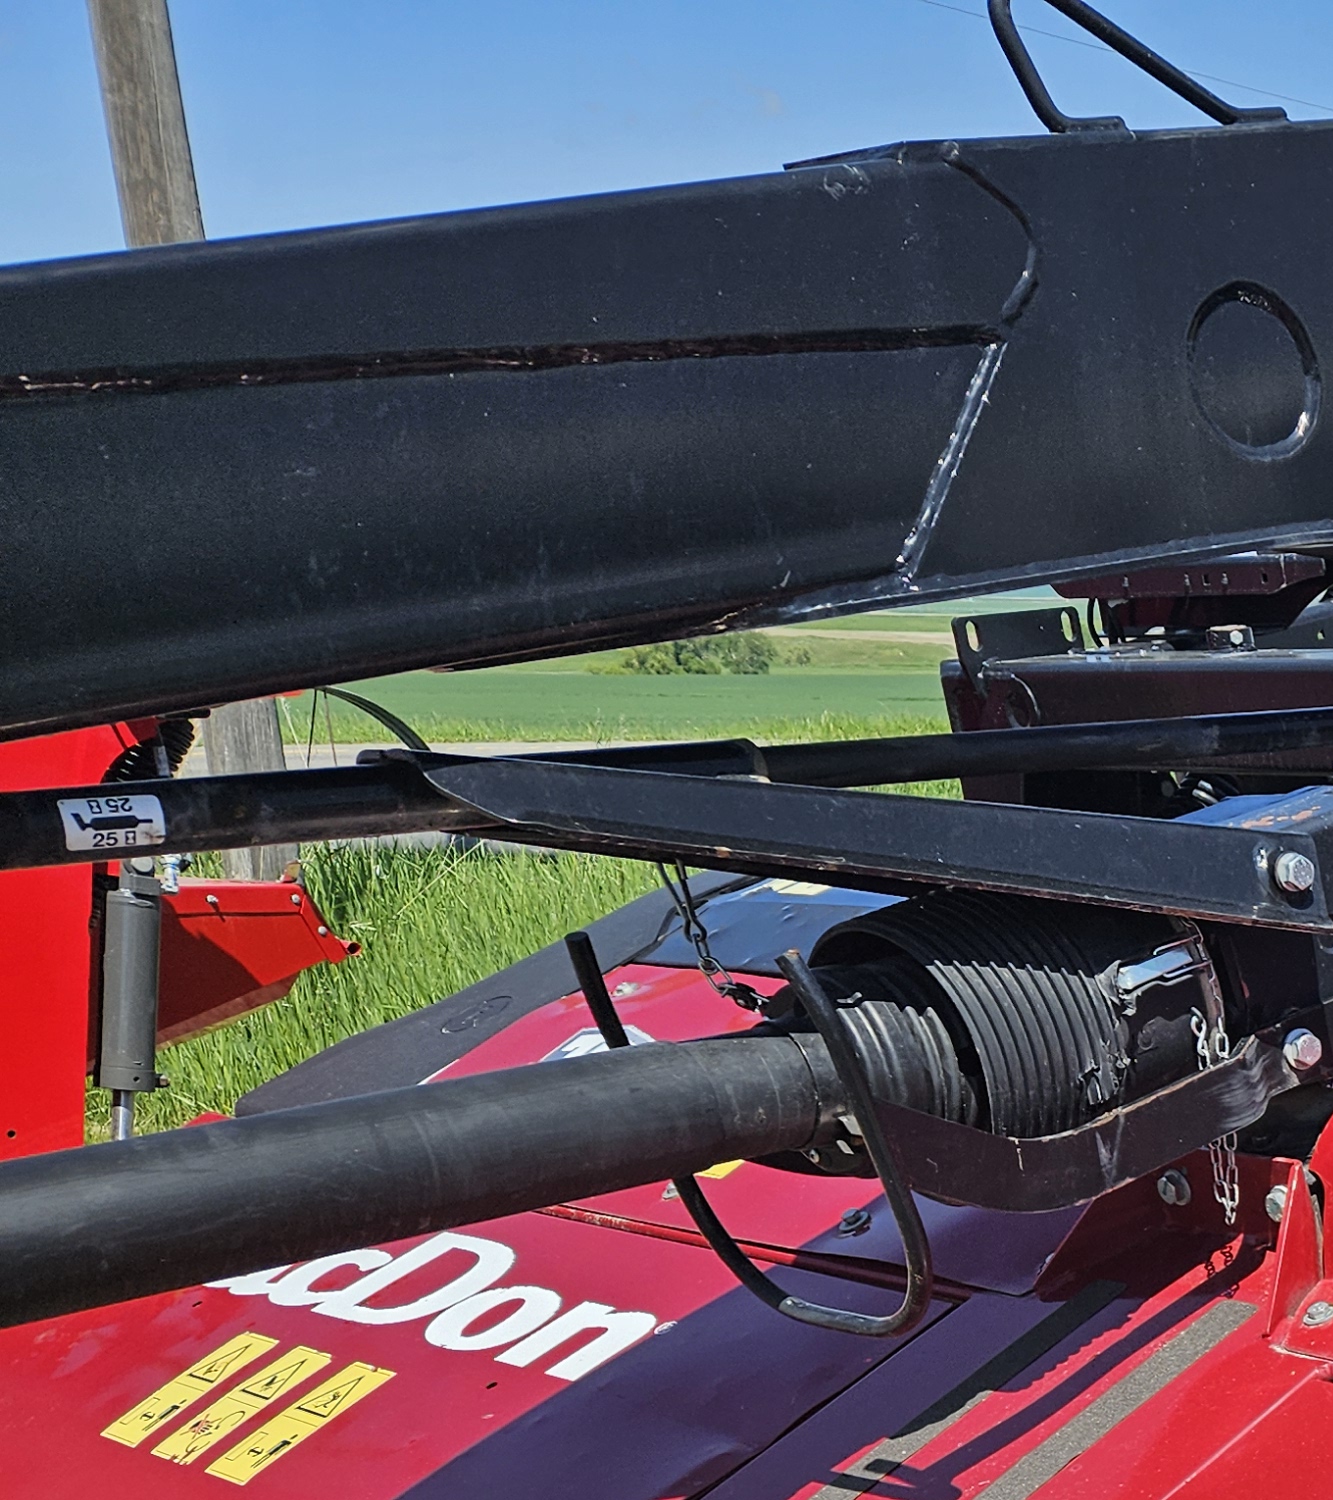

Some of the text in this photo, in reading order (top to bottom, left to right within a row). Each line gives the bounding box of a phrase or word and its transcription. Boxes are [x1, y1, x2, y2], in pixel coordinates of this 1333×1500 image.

[105, 797, 133, 813] 25
[92, 832, 119, 847] 25
[203, 1231, 657, 1381] cDon
